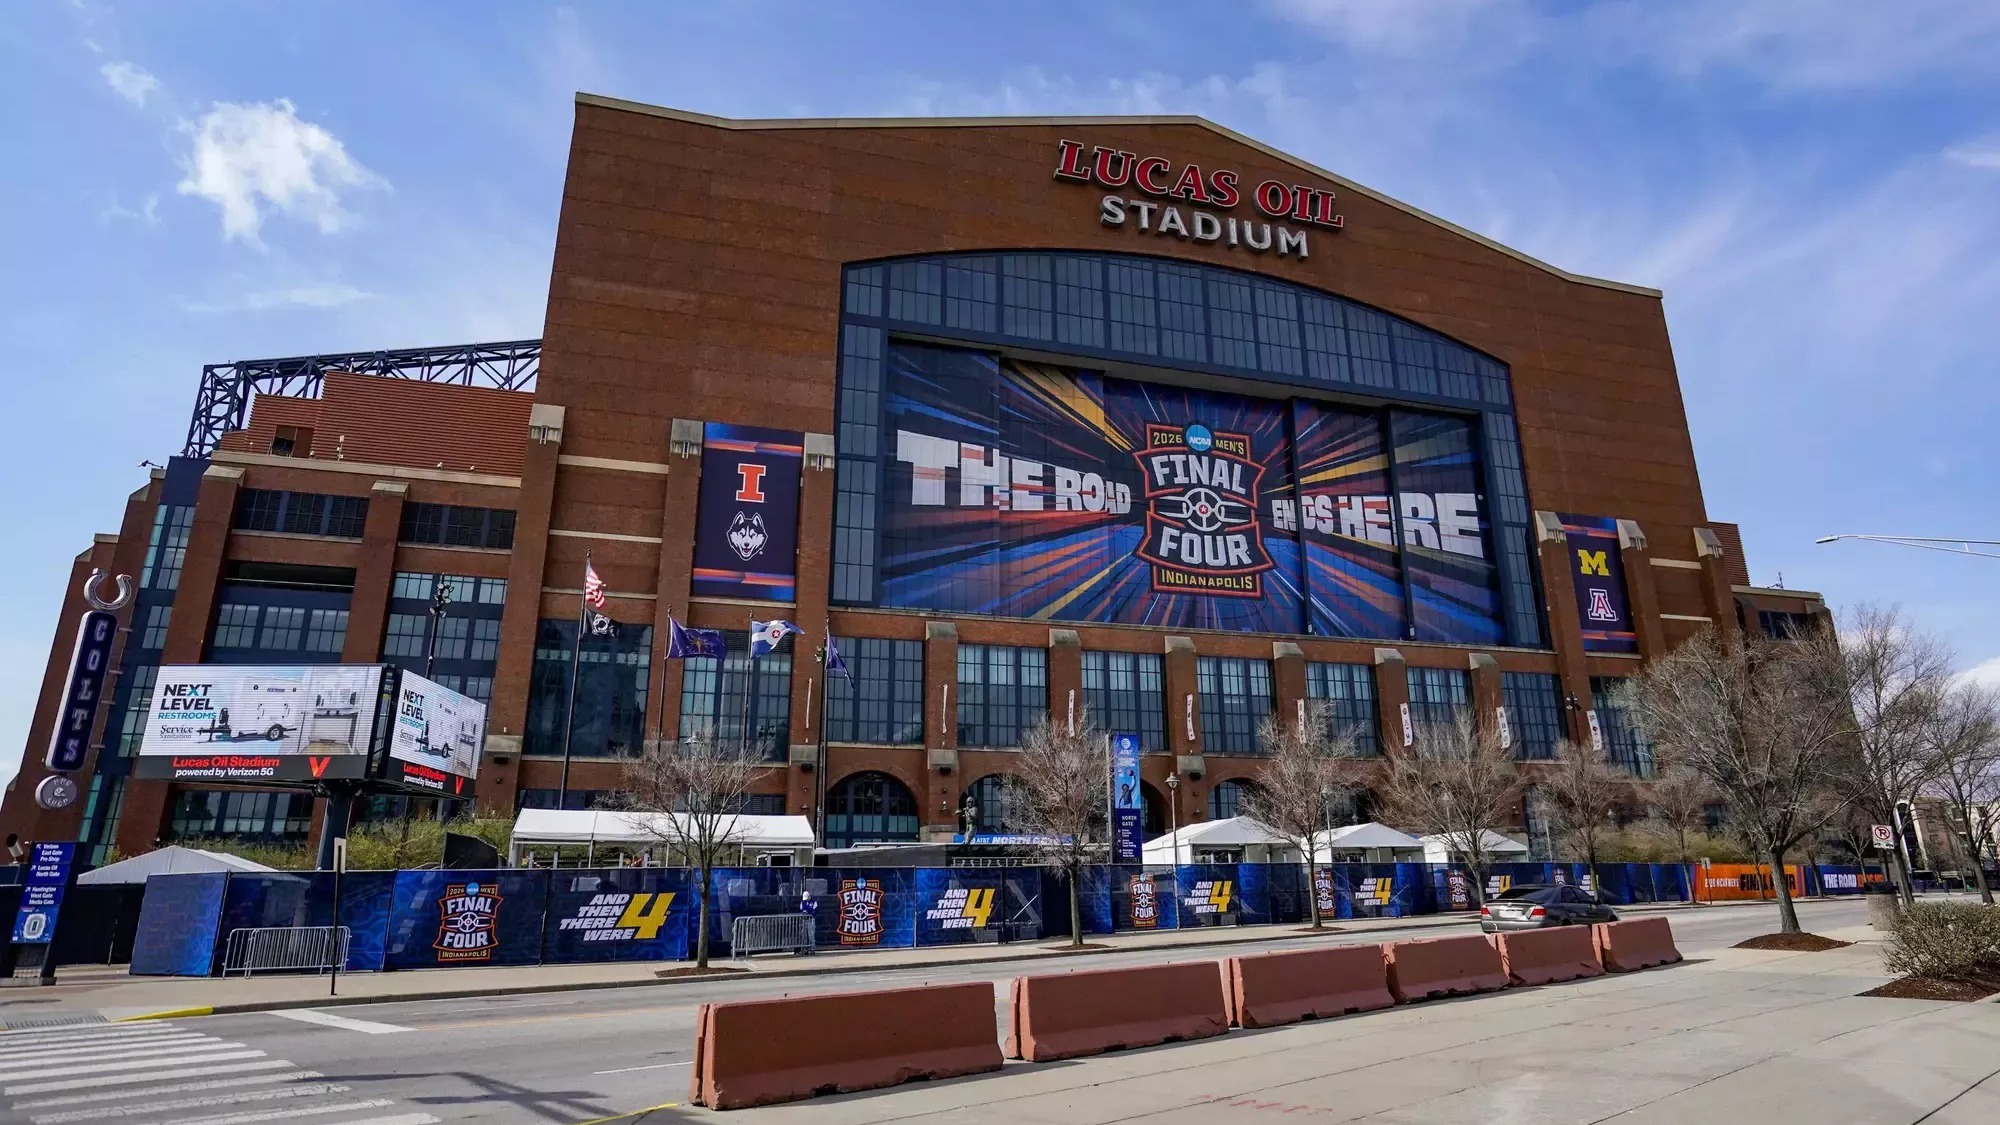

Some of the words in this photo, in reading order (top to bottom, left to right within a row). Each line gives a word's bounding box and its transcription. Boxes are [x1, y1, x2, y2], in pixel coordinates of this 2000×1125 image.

[1053, 139, 1240, 207] LUCAS
[1253, 180, 1344, 228] OIL
[1101, 195, 1309, 258] STADIUM
[1153, 432, 1183, 445] 2026
[1189, 436, 1211, 445] NCAA
[1215, 439, 1244, 455] MEN'S
[1151, 454, 1246, 495] FINAL
[897, 429, 1044, 511] THE
[1055, 465, 1131, 515] ROAD
[1338, 492, 1484, 559] HERE
[1159, 526, 1252, 567] FOUR
[1577, 549, 1610, 576] M
[1161, 569, 1253, 590] INDIANAPOLIS
[1588, 588, 1617, 621] A
[62, 618, 110, 762] COLTS
[163, 684, 212, 696] NEXT
[160, 698, 214, 710] LEVEL
[403, 689, 425, 707] NEXT
[158, 712, 217, 720] RESTROOMS
[401, 702, 424, 721] LEVEL
[160, 724, 194, 734] Service
[173, 756, 210, 767] Lucas
[211, 756, 229, 767] Oil
[229, 756, 280, 767] Stadium
[175, 768, 214, 778] powered
[214, 767, 226, 778] by
[226, 768, 260, 776] Verizon
[260, 768, 274, 776] 5G
[404, 762, 418, 774] Lucas
[426, 767, 446, 782] Stadium
[45, 797, 68, 808] SHOP
[1195, 881, 1213, 889] AND
[1315, 879, 1332, 890] FINAL
[1823, 874, 1838, 889] THE
[1838, 874, 1857, 888] ROAD
[944, 889, 969, 899] AND
[1132, 883, 1153, 895] FINAL
[1191, 889, 1212, 897] THEN
[1354, 891, 1375, 899] THERE
[1374, 877, 1393, 905] 4
[589, 893, 630, 905] AND
[843, 890, 877, 905] FINAL
[937, 898, 966, 909] THEN
[1184, 897, 1210, 906] THERE
[1195, 904, 1218, 914] WERE
[1208, 880, 1233, 913] 4
[446, 896, 492, 914] FINAL
[577, 905, 625, 918] THEN
[942, 917, 974, 929] WERE
[961, 888, 996, 927] 4
[1317, 899, 1334, 910] FOUR
[583, 928, 635, 941] WERE
[615, 892, 676, 940] 4
[926, 909, 963, 919] THERE
[1134, 906, 1154, 919] FOUR
[559, 917, 618, 930] THERE
[843, 919, 877, 934] FOUR
[442, 931, 488, 949] FOUR
[442, 950, 487, 958] INDIANAPOLIS
